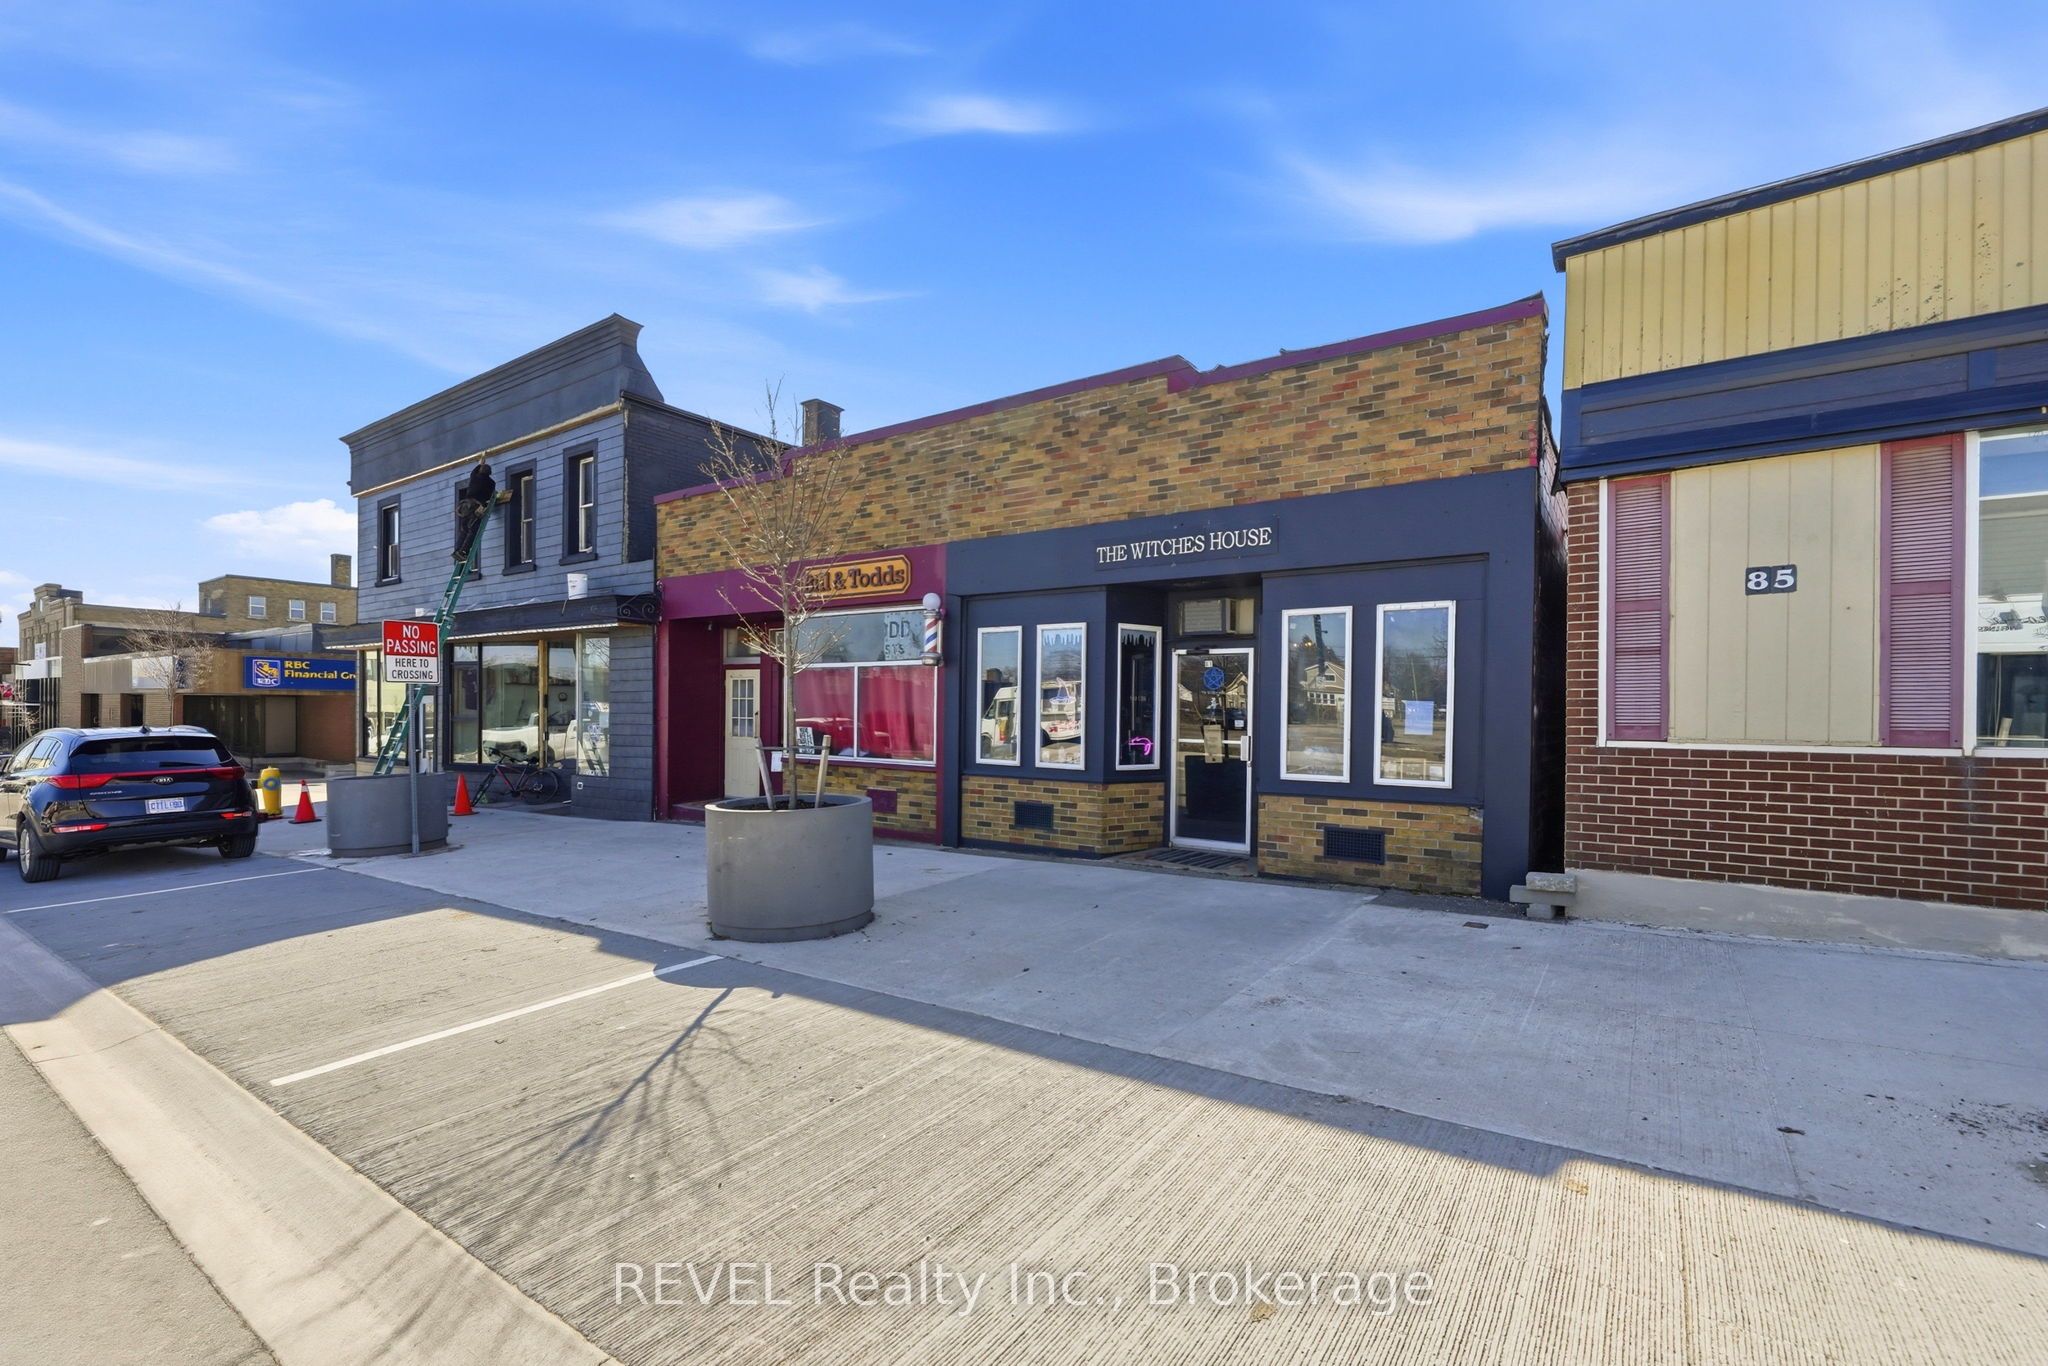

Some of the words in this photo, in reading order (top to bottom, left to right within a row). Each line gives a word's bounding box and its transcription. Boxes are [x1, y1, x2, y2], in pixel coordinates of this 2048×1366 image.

[1097, 545, 1128, 563] THE
[1131, 535, 1205, 560] WITCHES
[1209, 527, 1272, 550] HOUSE
[848, 565, 905, 589] Todds
[1747, 569, 1795, 590] 85
[402, 624, 420, 639] NO
[386, 639, 436, 654] PASSING
[284, 661, 311, 669] RBC
[395, 658, 417, 667] HERE
[419, 659, 429, 668] TO
[284, 669, 338, 679] Financial
[391, 669, 434, 679] CROSSING
